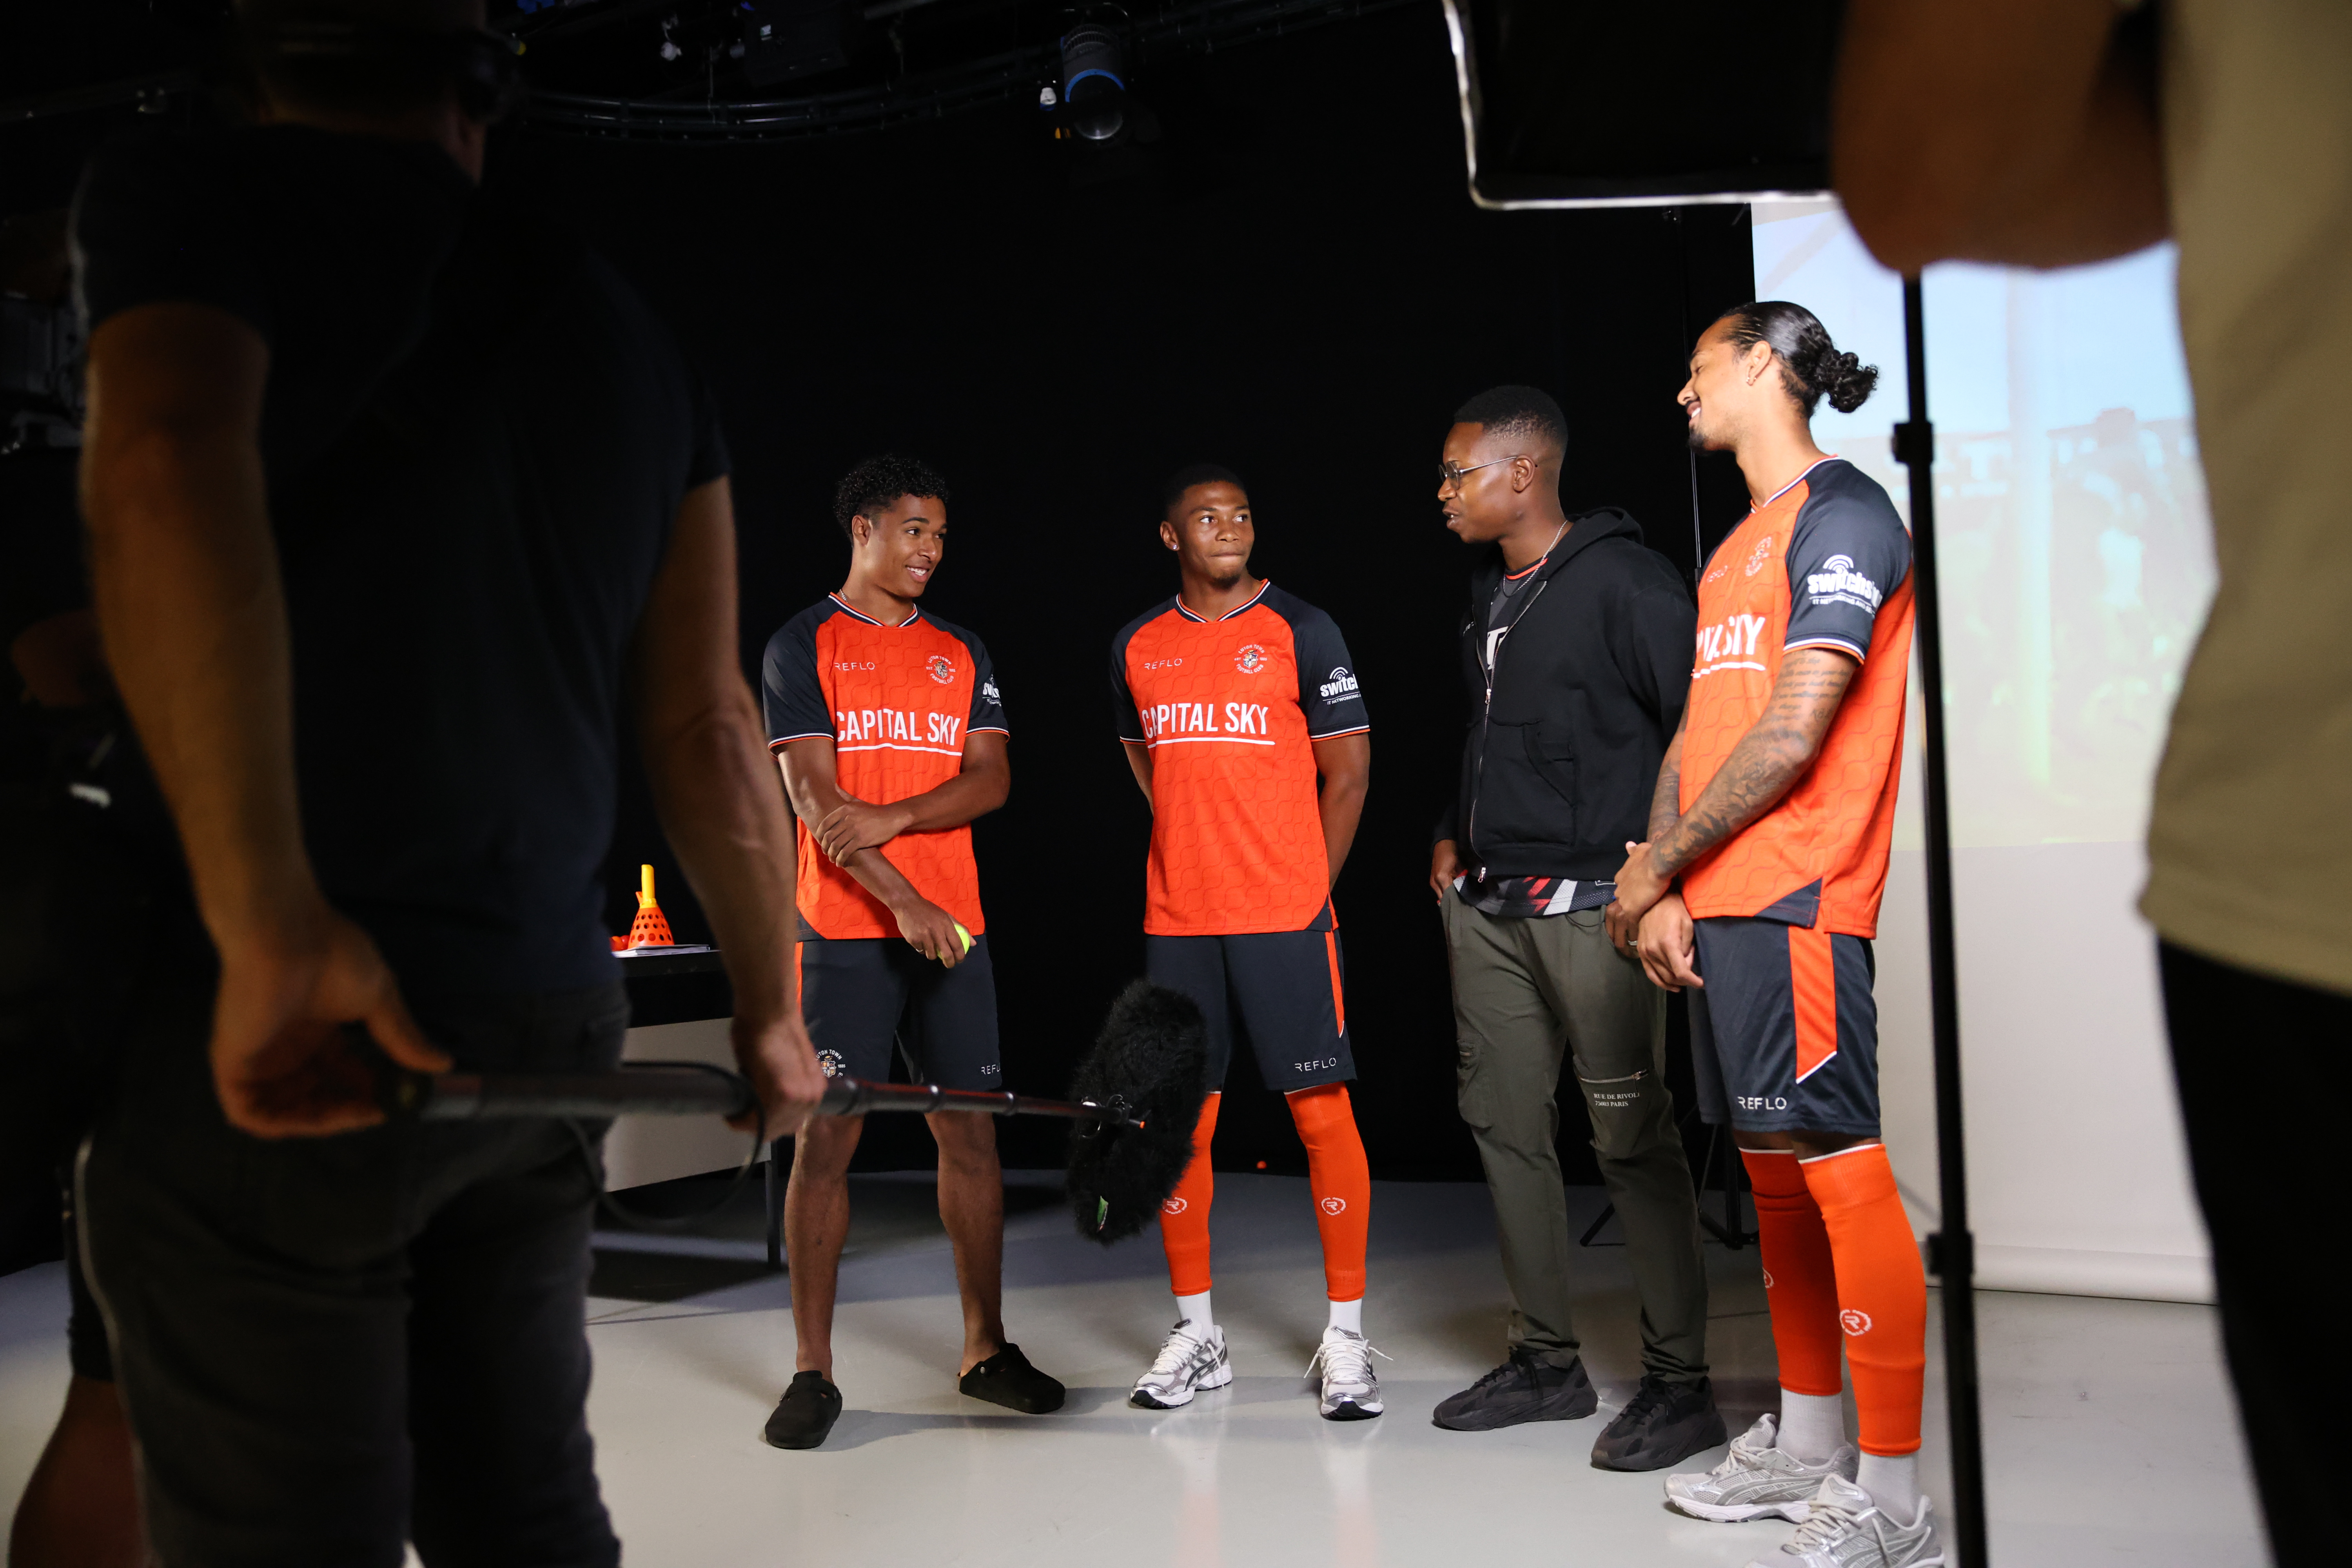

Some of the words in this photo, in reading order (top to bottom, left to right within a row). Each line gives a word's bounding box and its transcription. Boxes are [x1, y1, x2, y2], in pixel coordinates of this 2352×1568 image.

[1238, 644, 1253, 654] LUTON
[1254, 644, 1265, 653] TOWN
[927, 655, 939, 663] LUTON
[939, 655, 952, 665] TOWN
[1144, 658, 1183, 670] REFLO
[834, 662, 875, 671] REFLO
[1236, 664, 1254, 674] FOOTBALL
[1254, 664, 1264, 673] CLUB
[1332, 694, 1359, 704] NETWORKING
[1142, 703, 1218, 739] CAPITAL
[1225, 702, 1269, 735] SKY
[837, 708, 922, 742] CAPITAL
[927, 712, 961, 746] SKY
[829, 1049, 842, 1060] TOWN
[981, 1064, 1000, 1075] REFL
[1294, 1057, 1336, 1072] REFLO
[1737, 1096, 1787, 1110] REFLO
